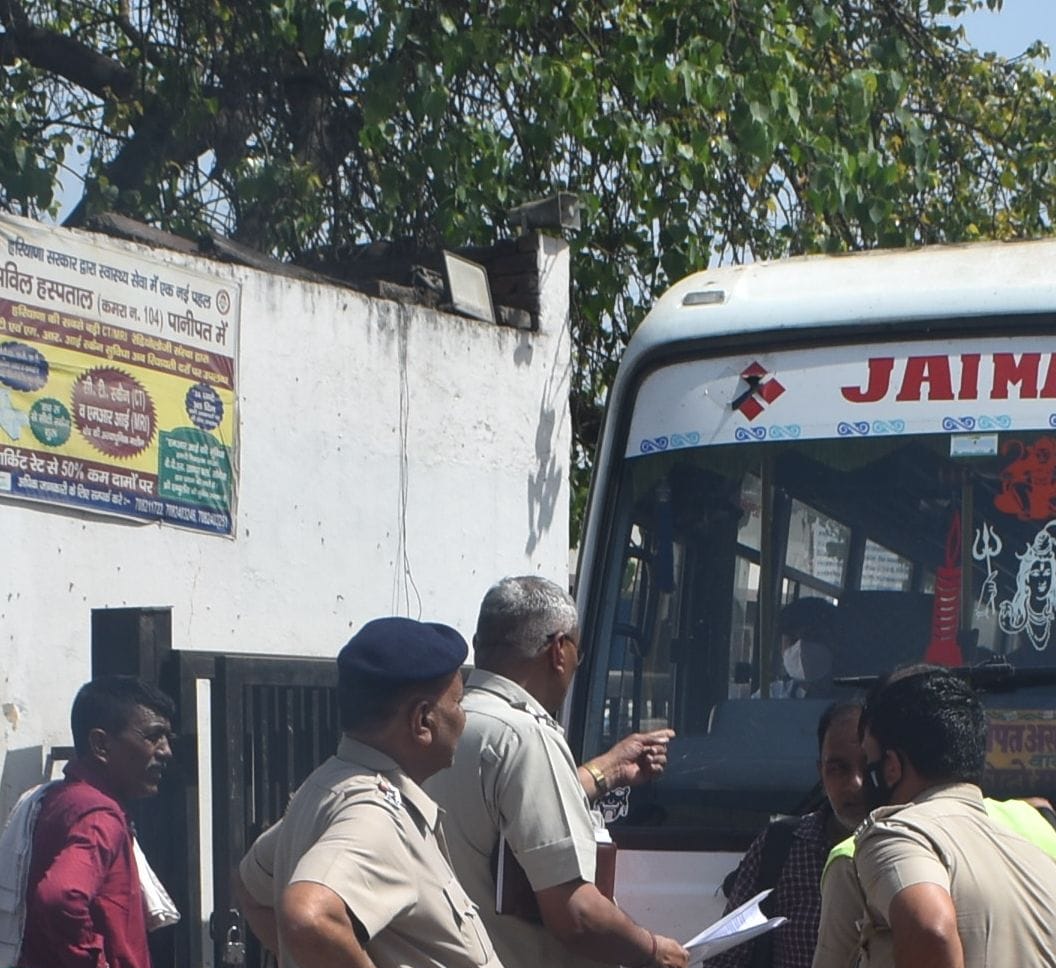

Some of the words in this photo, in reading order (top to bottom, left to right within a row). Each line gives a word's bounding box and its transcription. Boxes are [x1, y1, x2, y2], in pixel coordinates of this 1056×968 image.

[8, 236, 44, 262] हरियाणा
[47, 249, 77, 271] सरकार
[80, 259, 97, 276] द्वारा
[99, 263, 129, 285] स्वास्थ्य
[131, 270, 147, 290] सेवा
[150, 274, 159, 293] में
[160, 282, 174, 297] एक
[176, 283, 190, 304] नई
[192, 290, 211, 309] पहल
[36, 277, 94, 310] हस्पताल
[97, 293, 127, 319] (कमरा
[144, 305, 163, 332] 104)
[168, 309, 212, 342] पानीपत
[216, 320, 229, 345] में
[841, 353, 980, 403] JAI
[0, 447, 28, 470] ार्किट
[30, 453, 45, 473] रेट
[47, 457, 59, 475] से
[60, 460, 84, 480] 50%
[87, 467, 109, 485] कम
[111, 471, 139, 490] दामों
[139, 478, 154, 494] पर
[17, 474, 39, 489] अधिक
[77, 484, 90, 500] लिए
